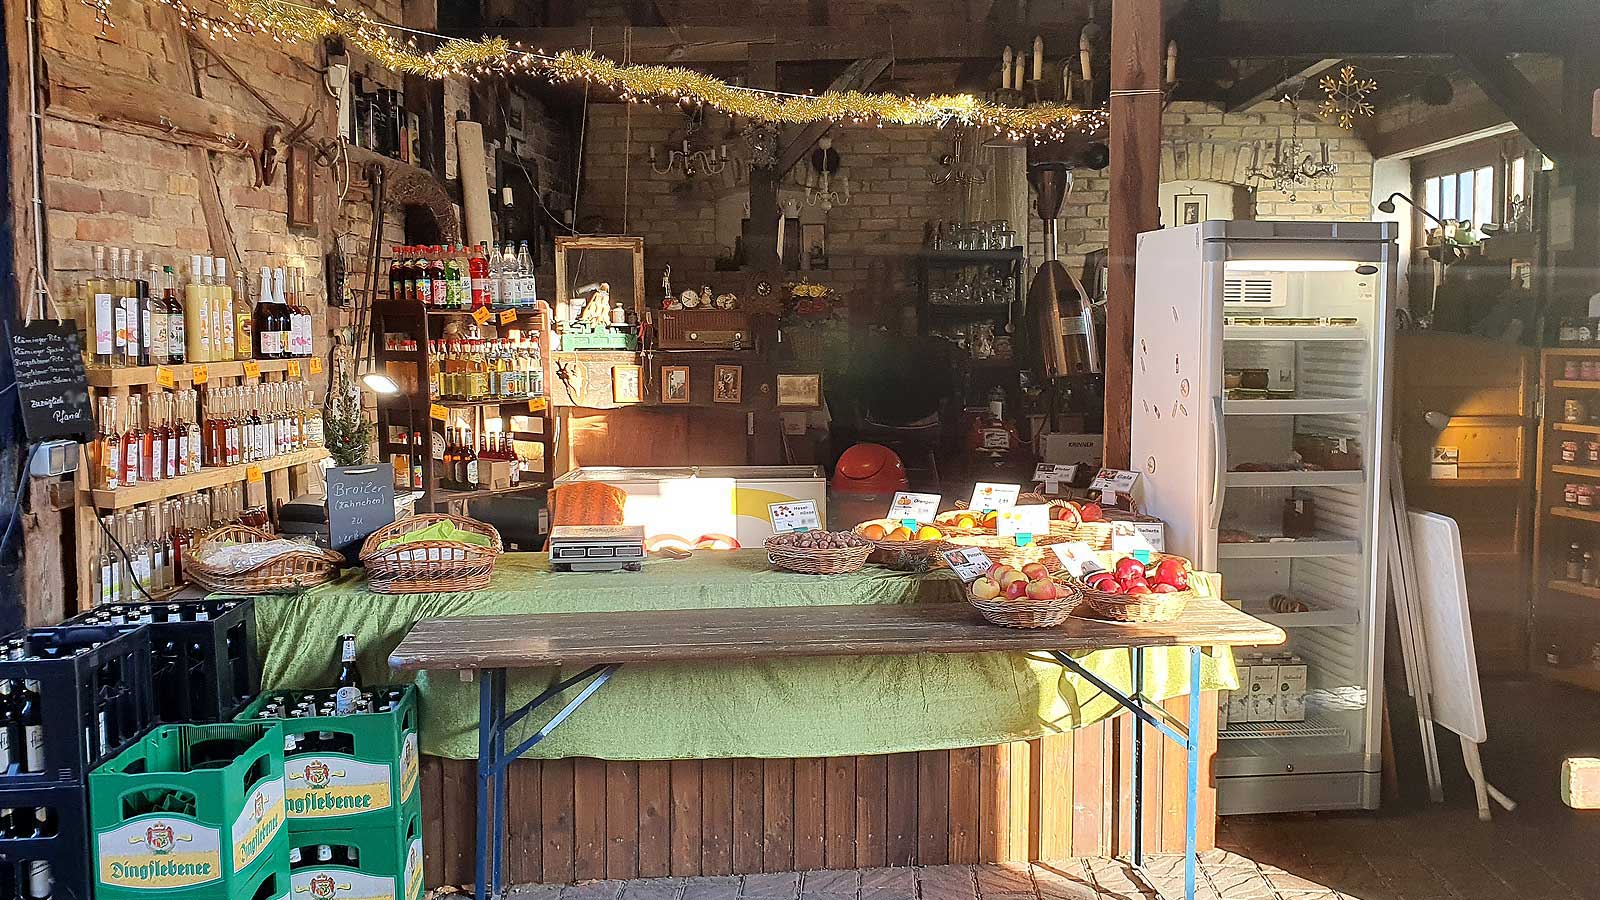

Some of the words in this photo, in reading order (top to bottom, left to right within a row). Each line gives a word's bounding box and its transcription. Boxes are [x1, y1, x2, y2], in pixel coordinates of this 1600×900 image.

[53, 409, 81, 424] Pfand
[332, 481, 386, 497] Broiler
[351, 516, 363, 525] zu
[287, 791, 372, 814] ngslebener
